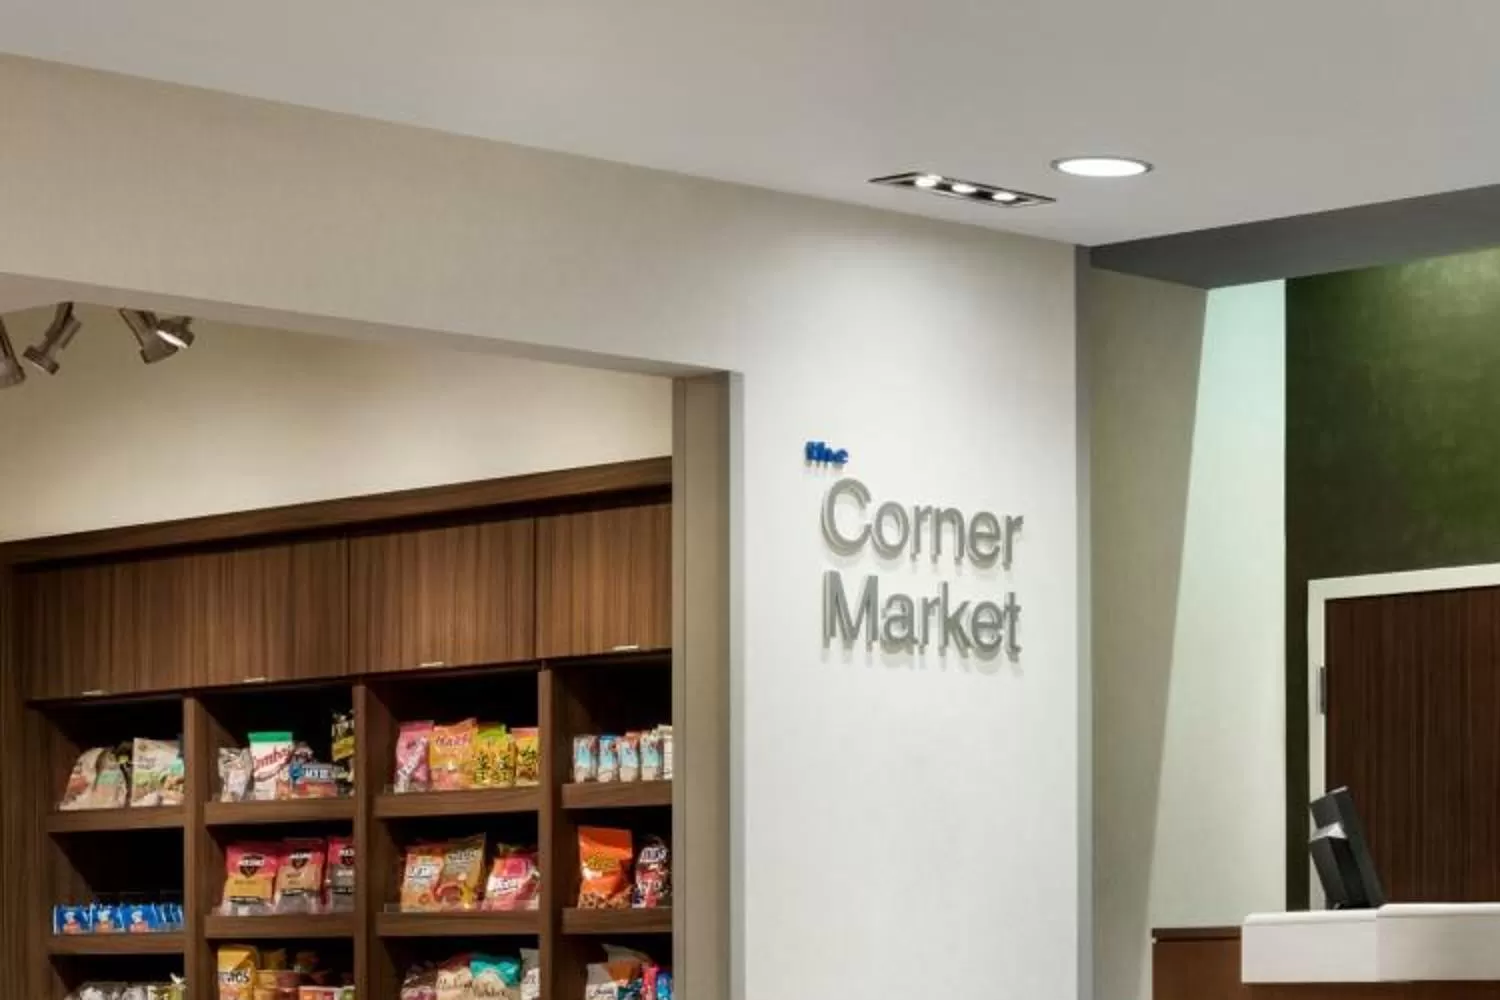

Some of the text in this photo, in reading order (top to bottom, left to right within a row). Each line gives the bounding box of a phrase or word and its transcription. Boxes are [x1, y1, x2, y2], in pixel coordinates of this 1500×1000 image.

[804, 440, 849, 466] the
[821, 477, 1024, 571] Corner
[821, 570, 1023, 663] Market
